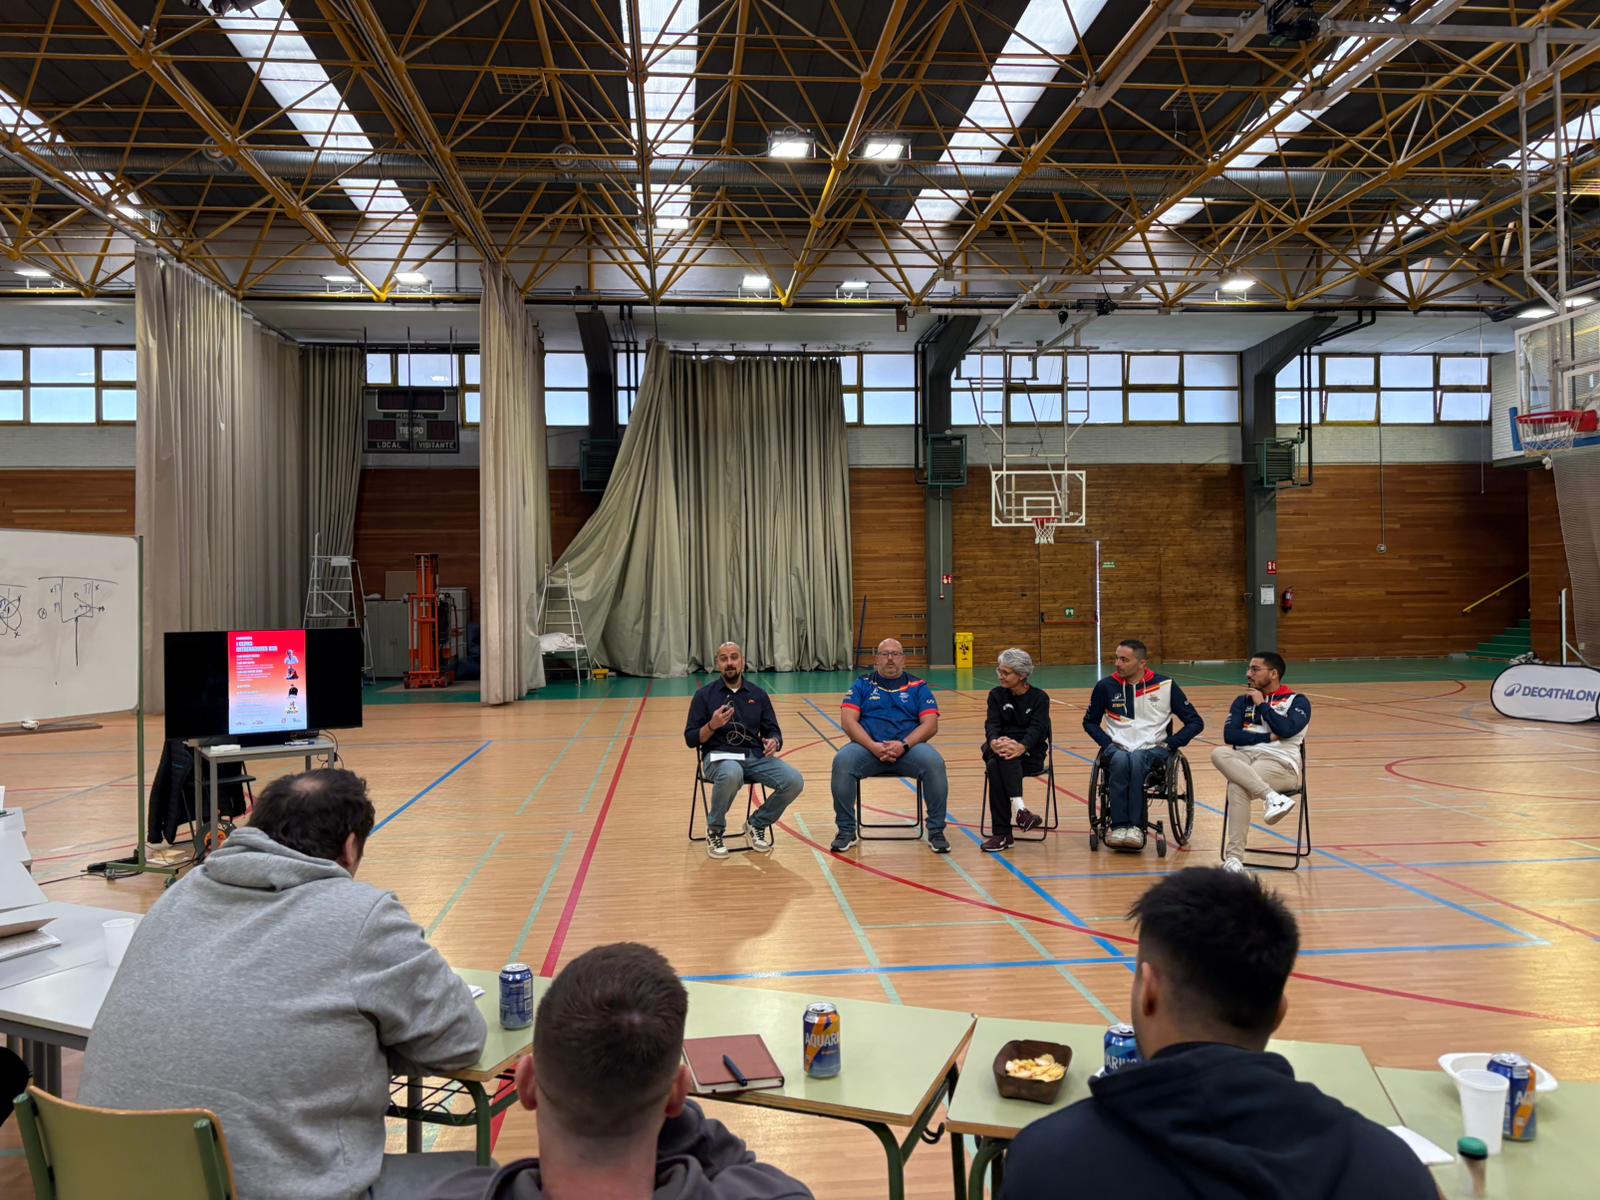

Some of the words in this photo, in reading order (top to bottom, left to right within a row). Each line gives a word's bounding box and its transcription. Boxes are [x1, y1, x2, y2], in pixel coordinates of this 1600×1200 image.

[399, 426, 424, 434] TIEPO
[376, 441, 401, 449] LOCAL
[418, 441, 454, 449] VISITANTE
[1522, 686, 1597, 702] DECATHLON
